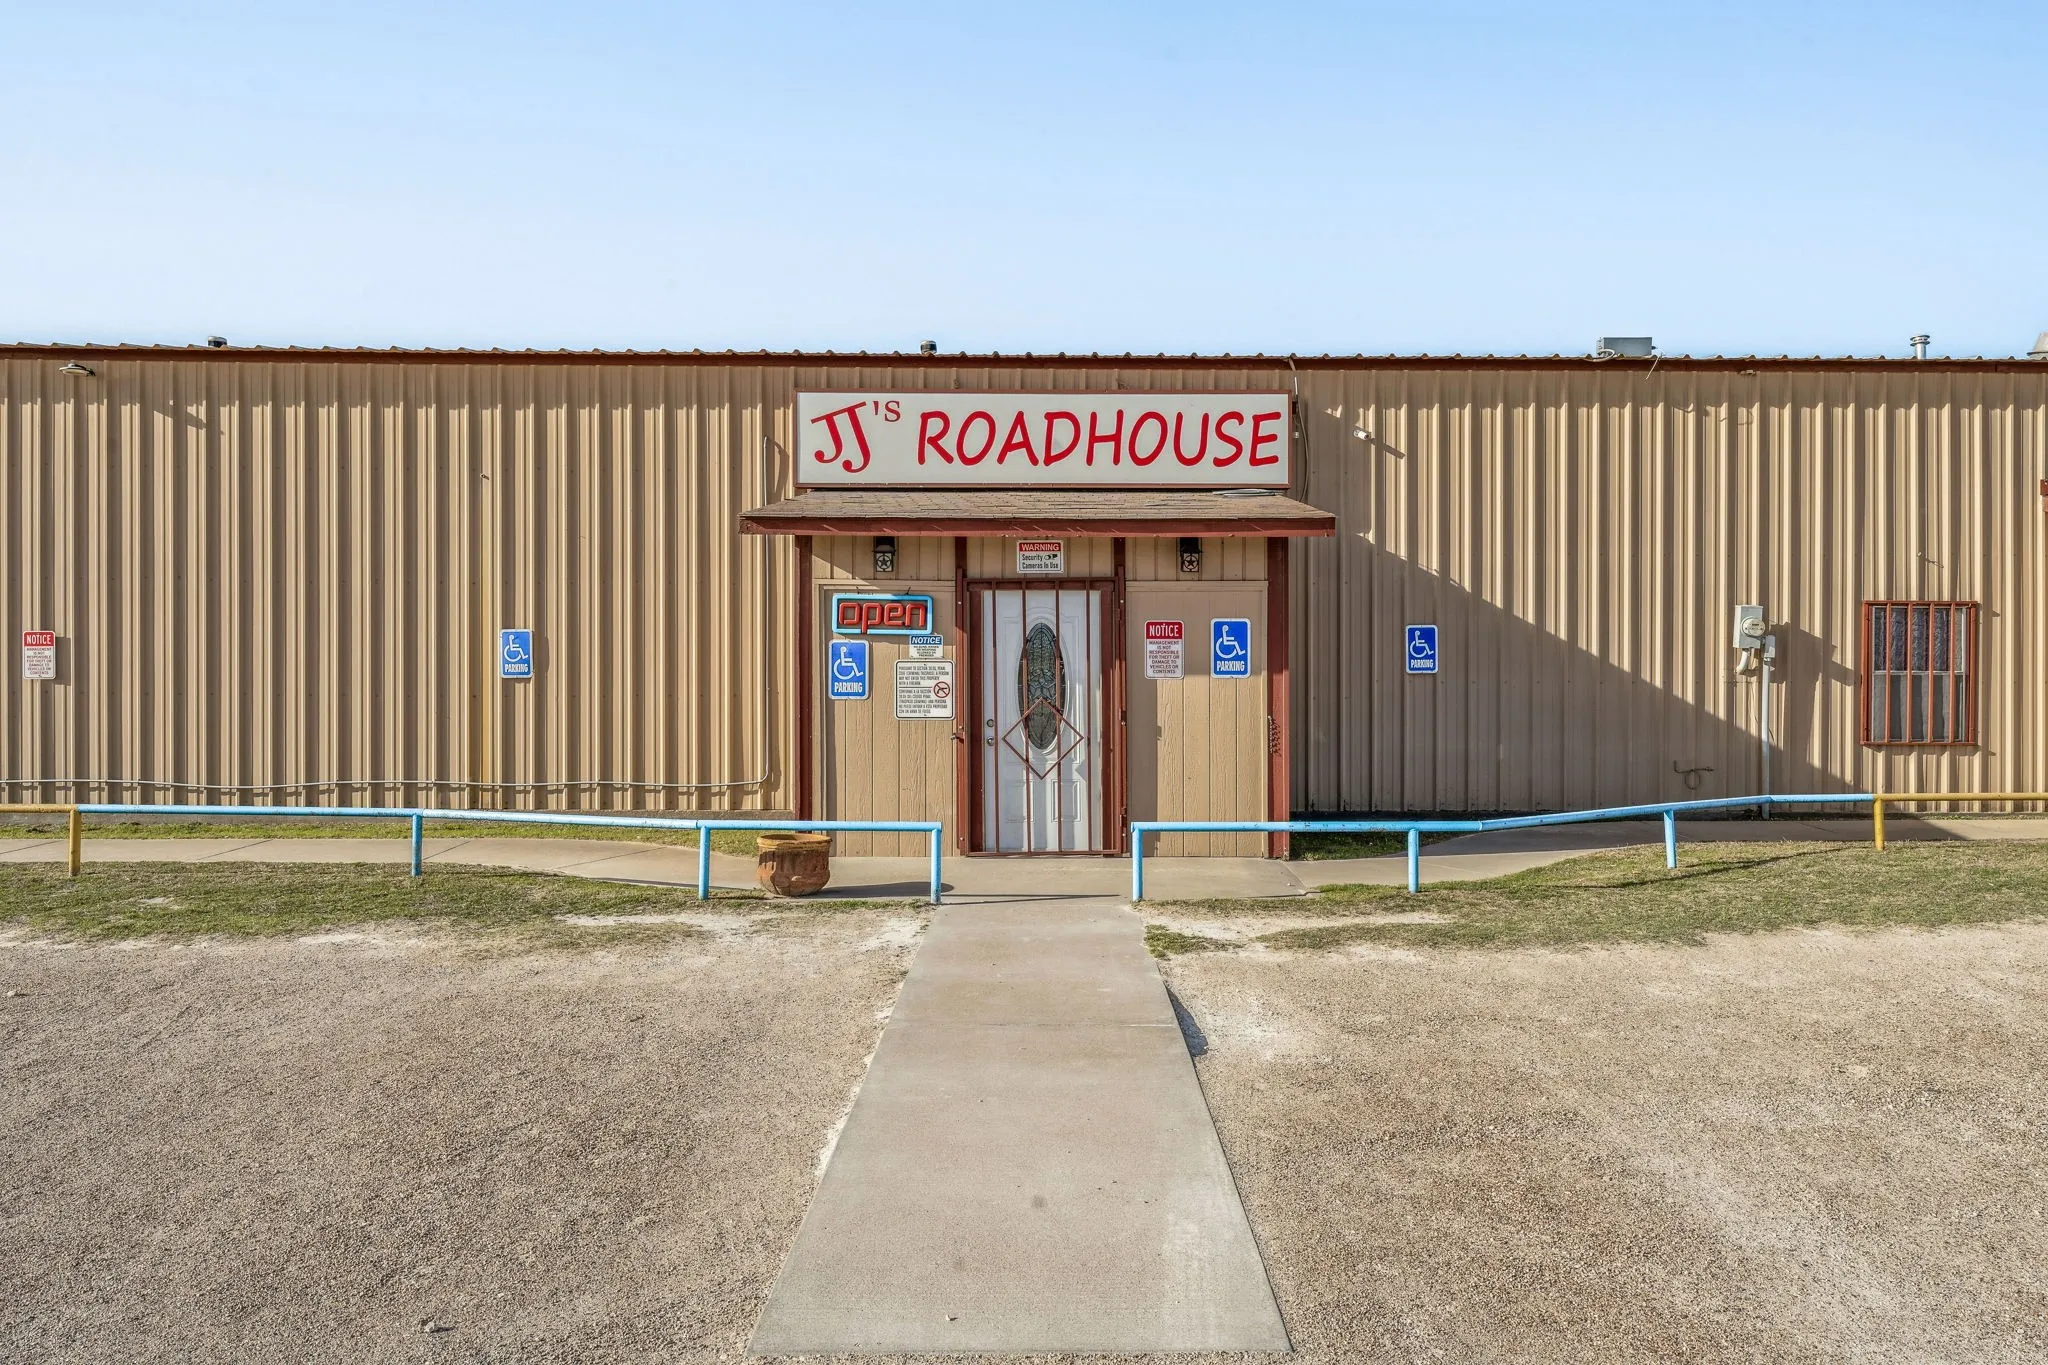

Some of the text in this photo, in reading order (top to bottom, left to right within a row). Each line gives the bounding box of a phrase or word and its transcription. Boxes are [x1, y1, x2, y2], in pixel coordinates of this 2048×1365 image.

[917, 409, 1281, 468] ROADHOUSE
[1021, 543, 1059, 551] WARNING
[839, 603, 926, 634] open
[1150, 625, 1179, 636] NOTICE
[26, 635, 51, 644] NOTICE
[911, 636, 940, 644] NOTICE
[505, 664, 528, 672] PARKING
[1216, 661, 1245, 671] PARKING
[1411, 659, 1434, 668] PARKING
[834, 682, 863, 693] PARKING
